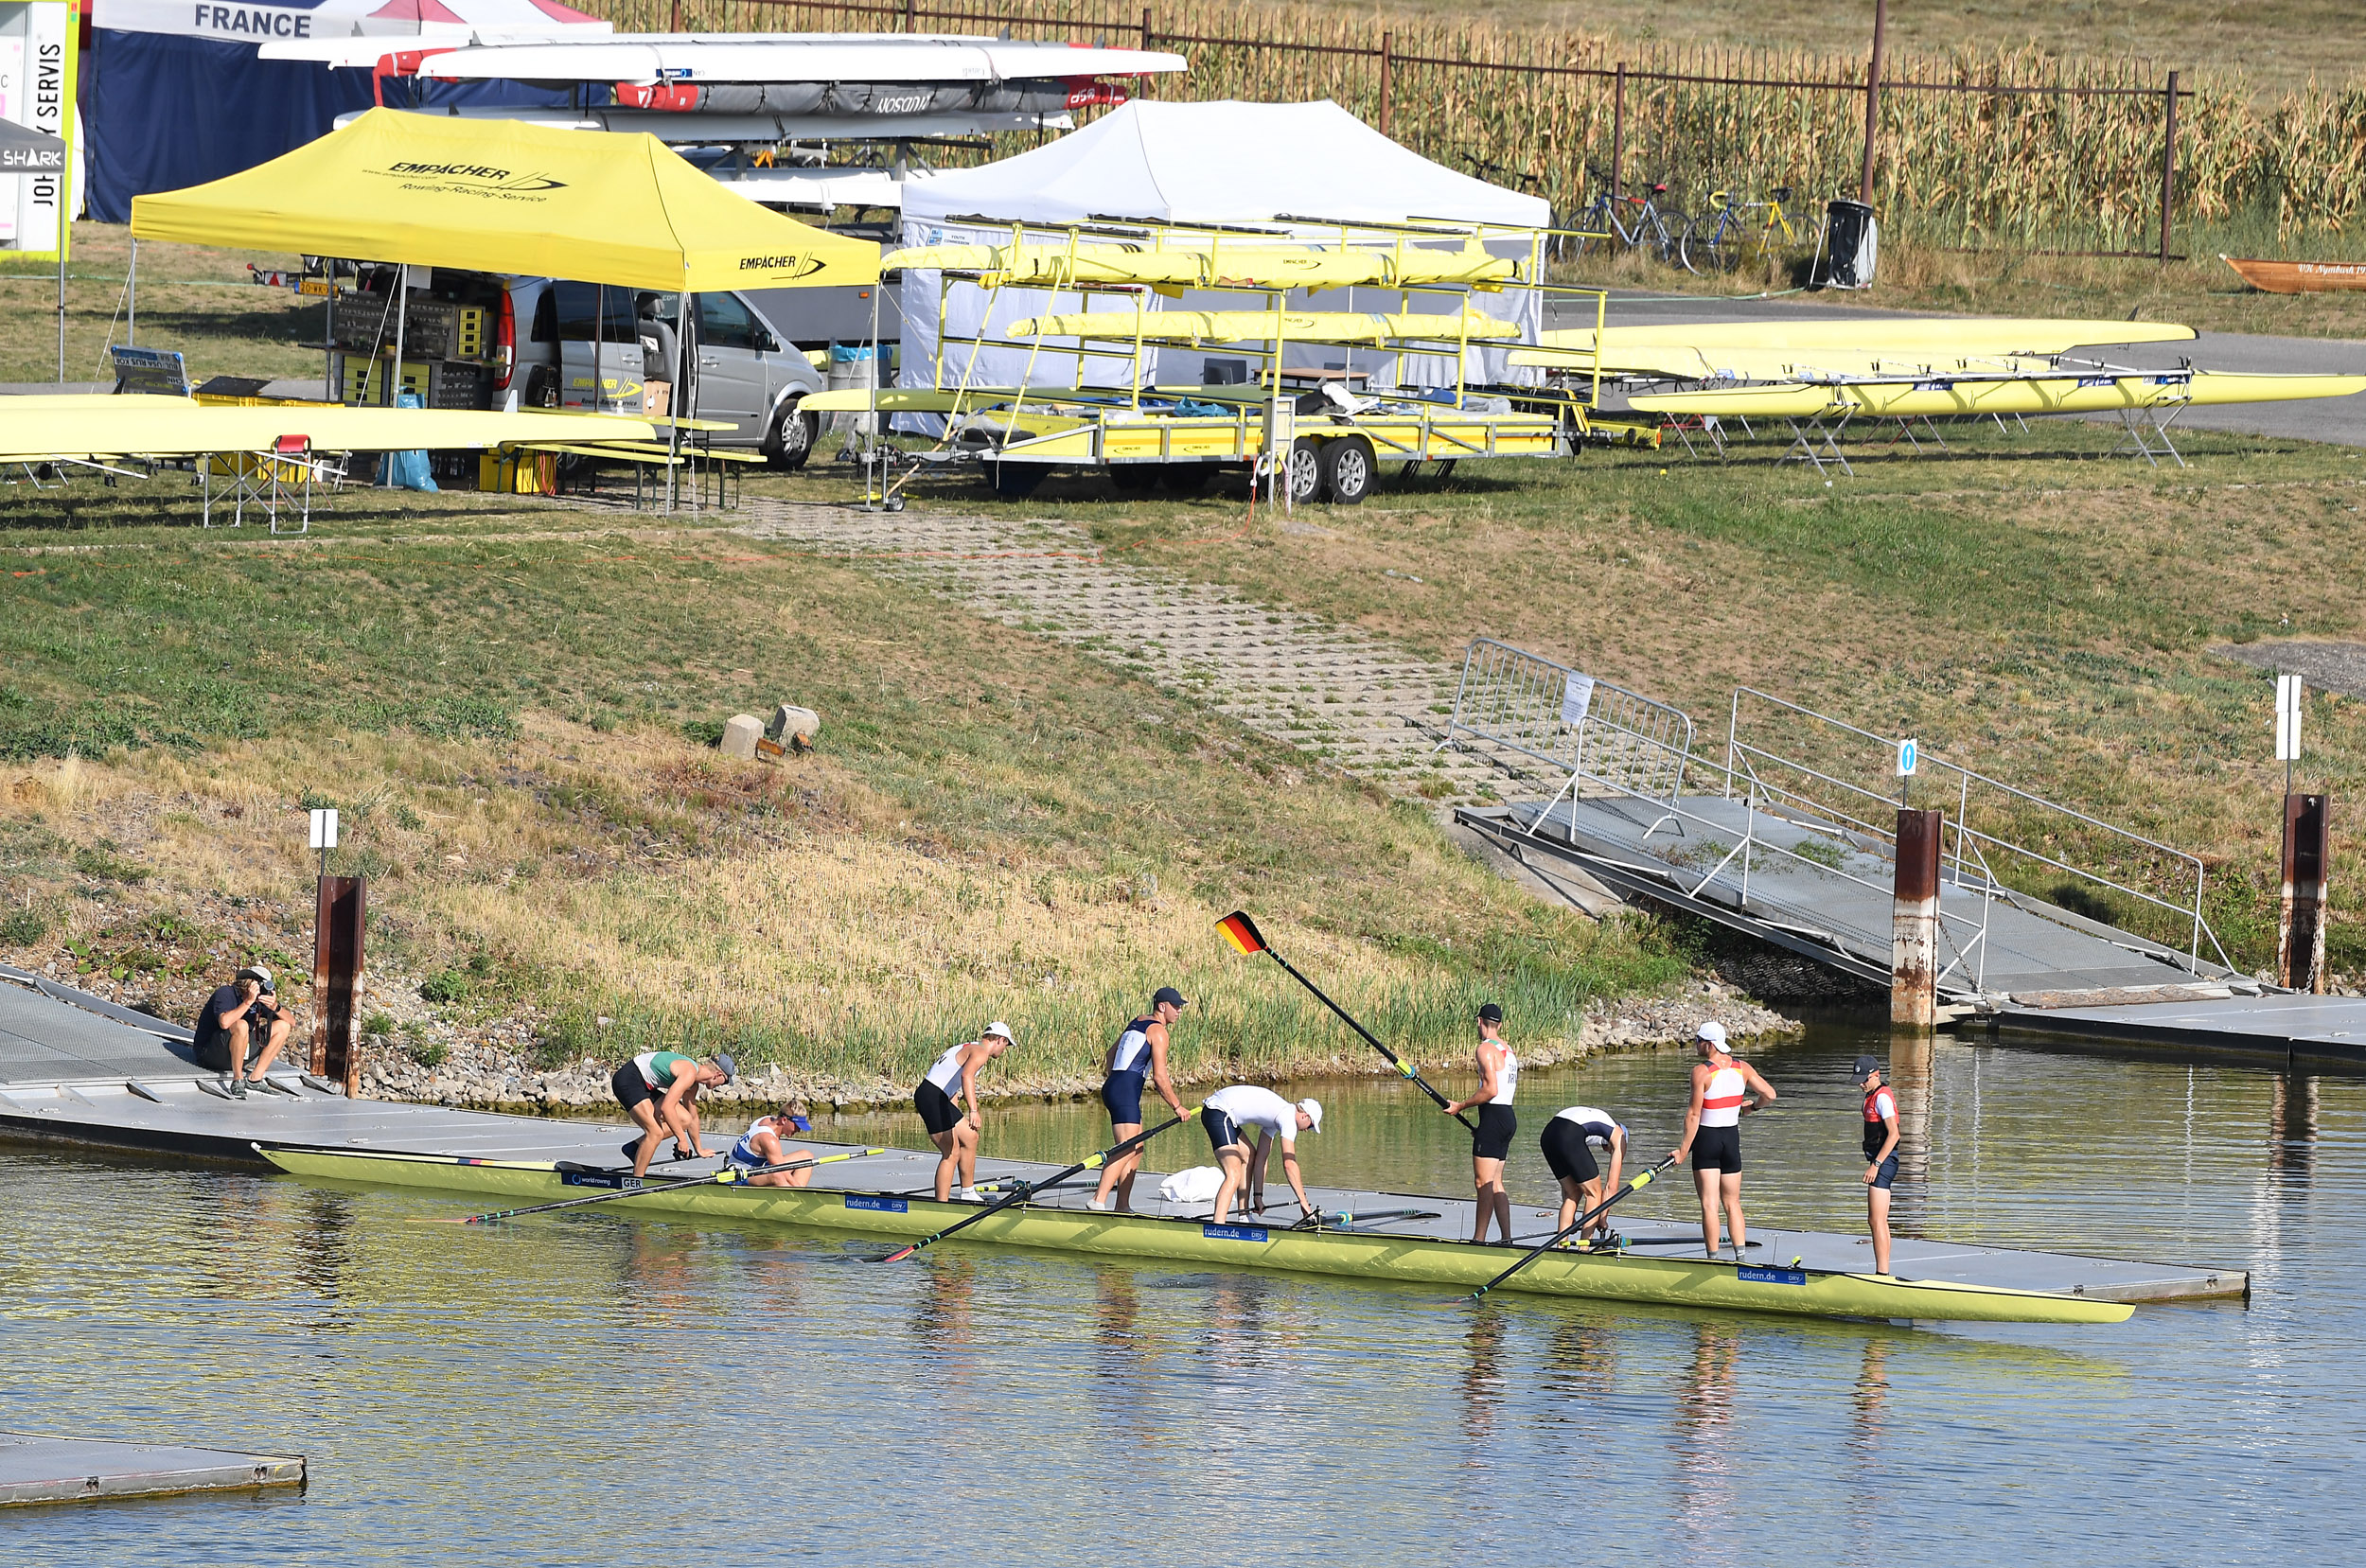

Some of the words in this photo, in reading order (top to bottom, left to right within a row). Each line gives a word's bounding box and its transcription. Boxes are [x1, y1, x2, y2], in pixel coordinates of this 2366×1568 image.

[195, 4, 311, 38] FRANCE
[36, 44, 61, 118] SERVIS
[3, 148, 62, 167] SHARK
[388, 162, 511, 181] EMPACHER
[399, 182, 548, 203] Rowing-Racing-Service
[739, 254, 796, 270] EMPACHER
[624, 1178, 642, 1189] GER
[846, 1198, 880, 1209] rudern.de
[1204, 1227, 1240, 1238] rudern.de
[1739, 1270, 1776, 1281] rudern.de
